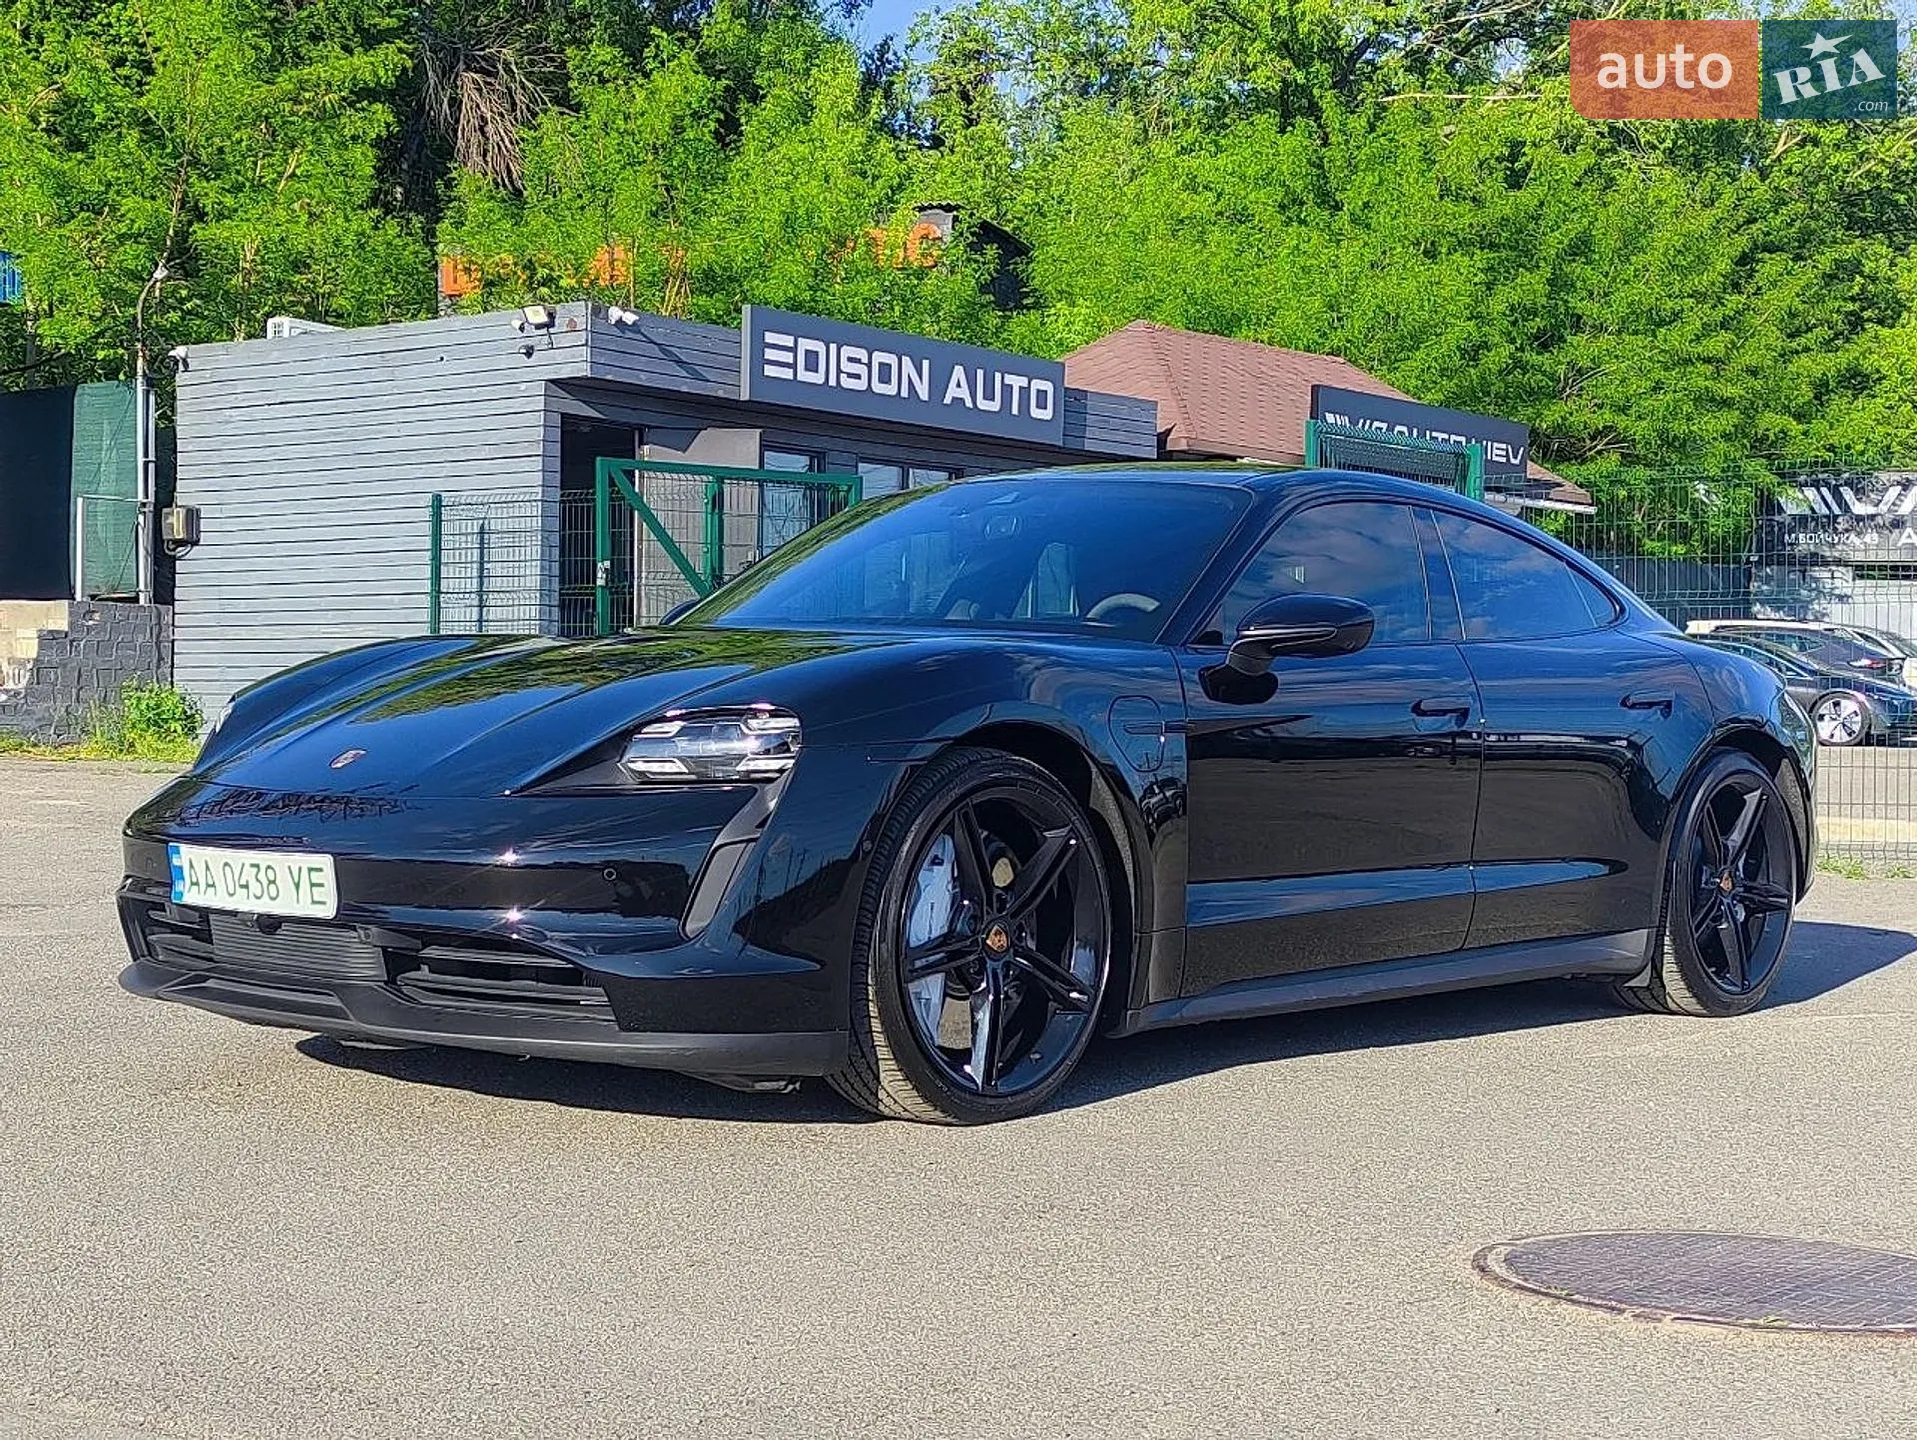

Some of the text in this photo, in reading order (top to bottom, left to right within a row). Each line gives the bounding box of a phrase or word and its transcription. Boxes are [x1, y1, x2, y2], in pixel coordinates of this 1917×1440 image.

[764, 331, 1055, 421] EDISON AUTO
[188, 857, 327, 906] AA 0438 YE
